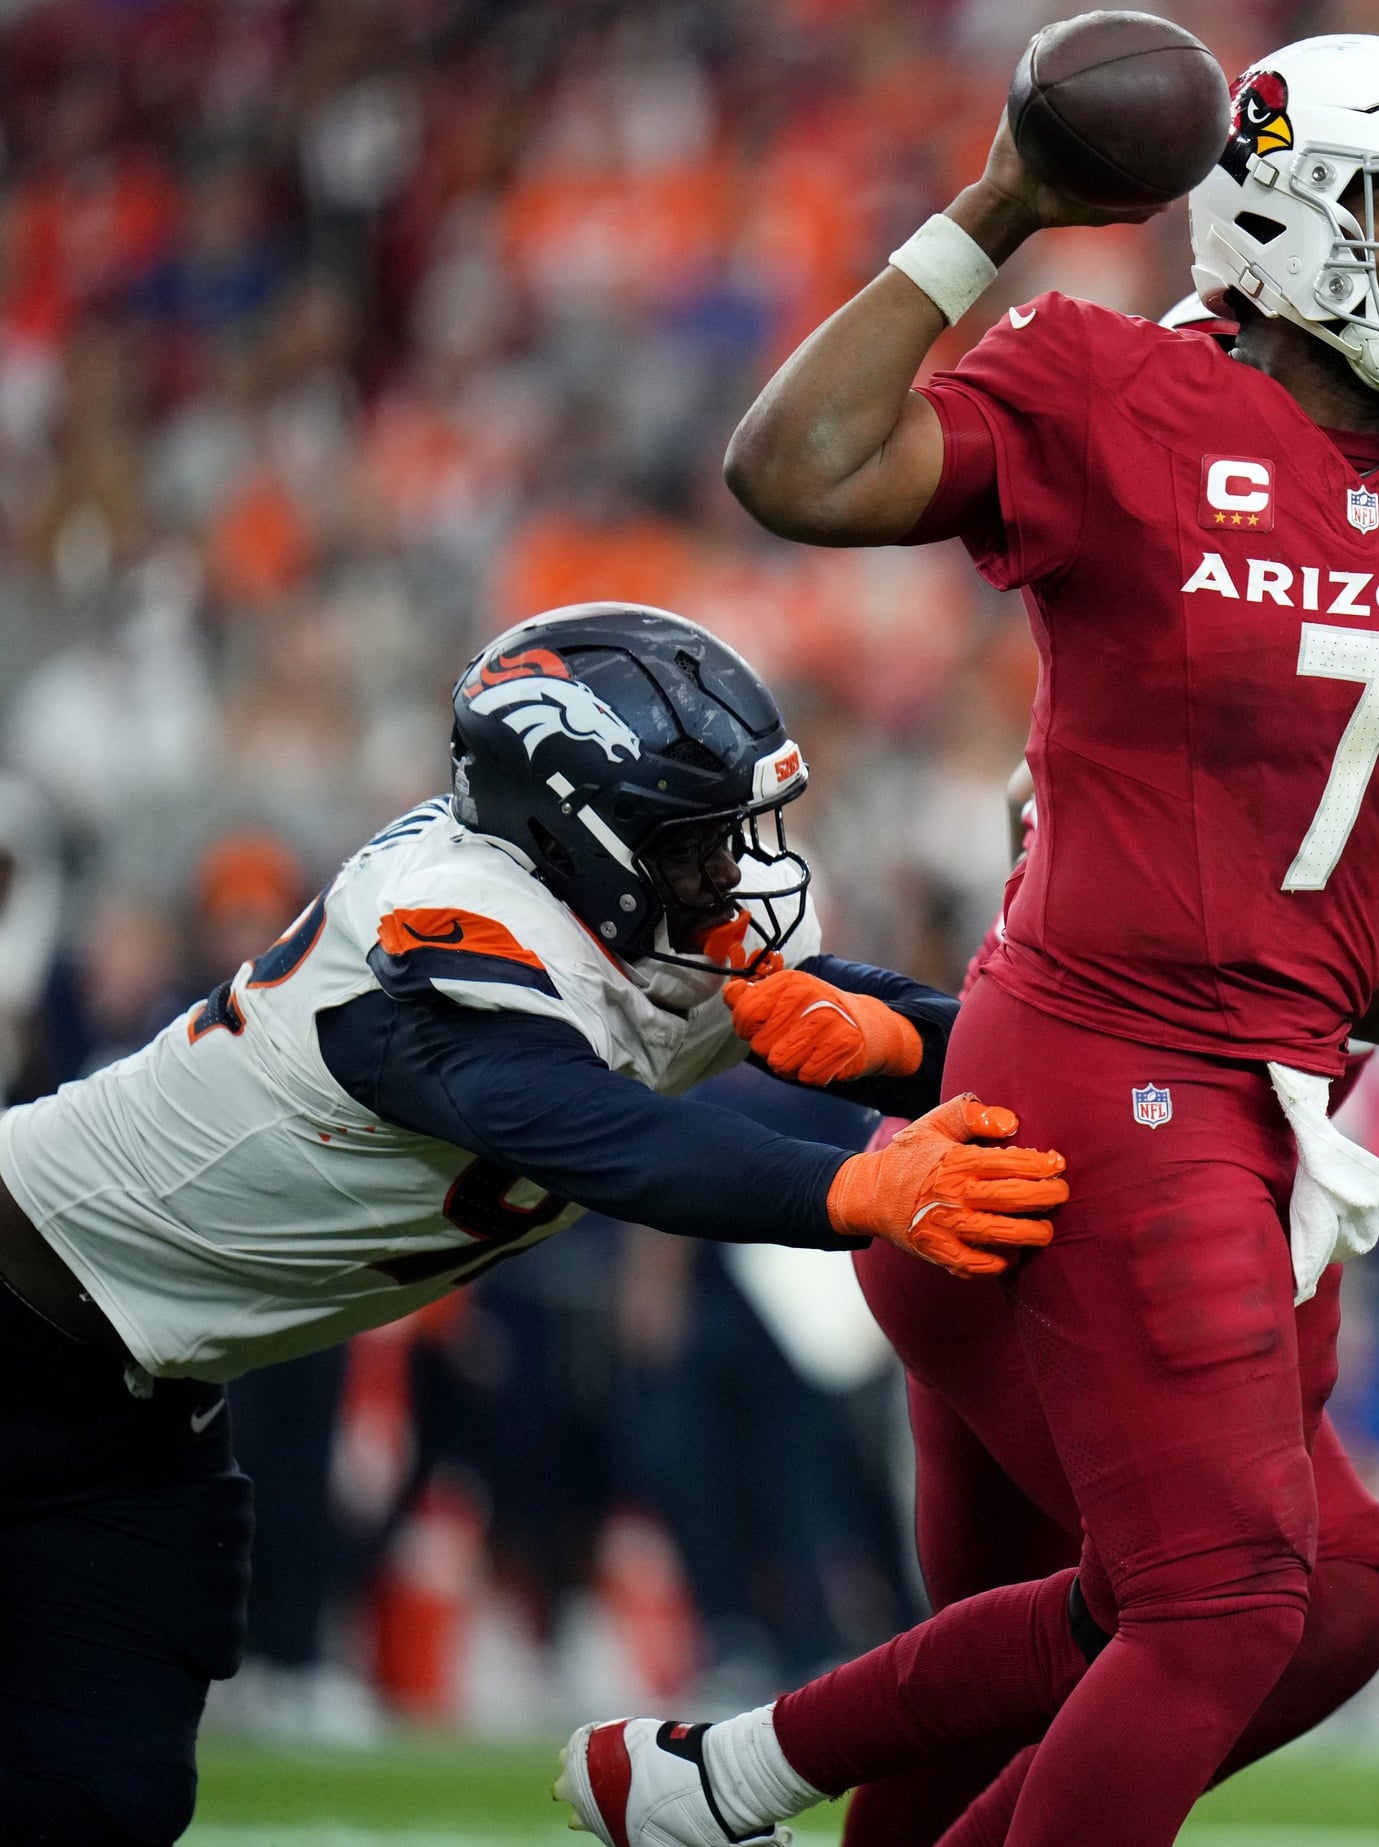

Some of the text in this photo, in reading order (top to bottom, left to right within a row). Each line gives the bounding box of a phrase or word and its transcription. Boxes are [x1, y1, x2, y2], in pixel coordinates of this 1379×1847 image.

[1207, 460, 1270, 511] C
[1353, 507, 1375, 525] NFL
[1140, 1103, 1166, 1120] NFL
